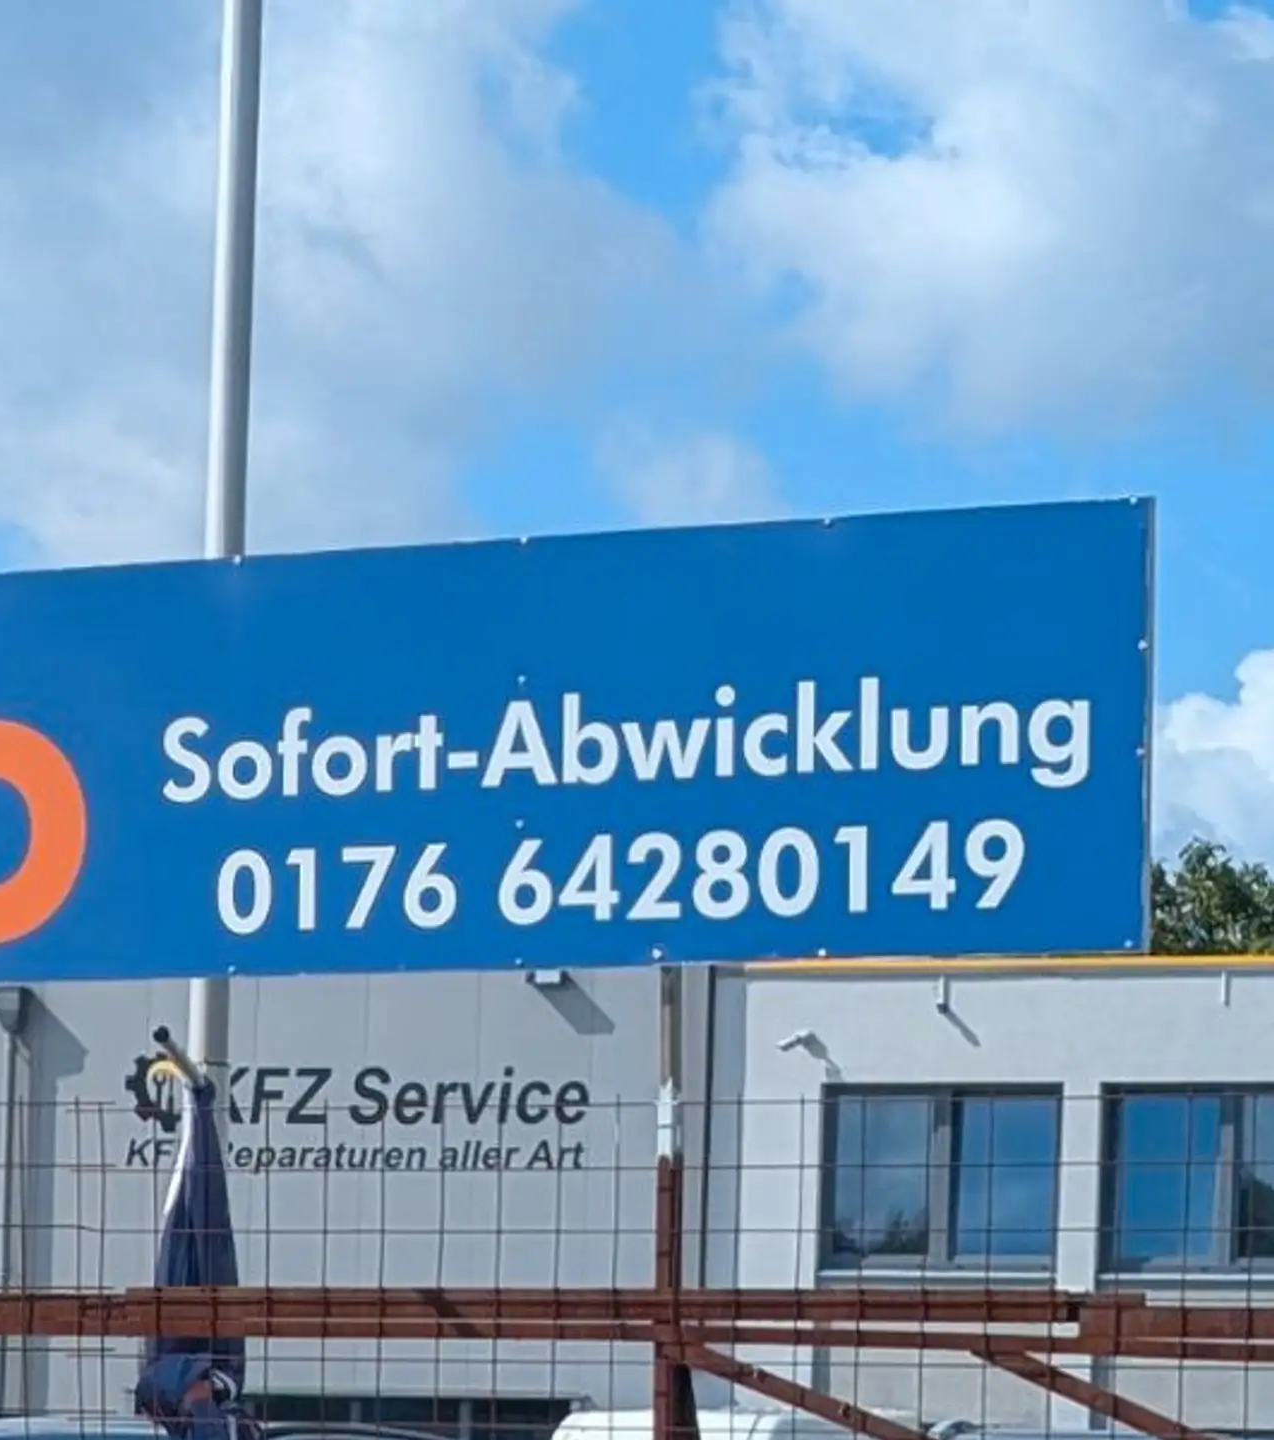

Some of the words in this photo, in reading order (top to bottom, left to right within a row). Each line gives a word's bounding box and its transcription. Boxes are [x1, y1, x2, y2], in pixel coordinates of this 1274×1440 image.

[162, 676, 1092, 802] Sofort-Abwicklung
[217, 843, 457, 935] 0176
[497, 818, 1026, 926] 64280149
[349, 1066, 591, 1125] Service
[126, 1138, 178, 1168] KF
[227, 1140, 427, 1174] eparaturen
[439, 1140, 519, 1170] aller
[527, 1139, 585, 1169] Art
